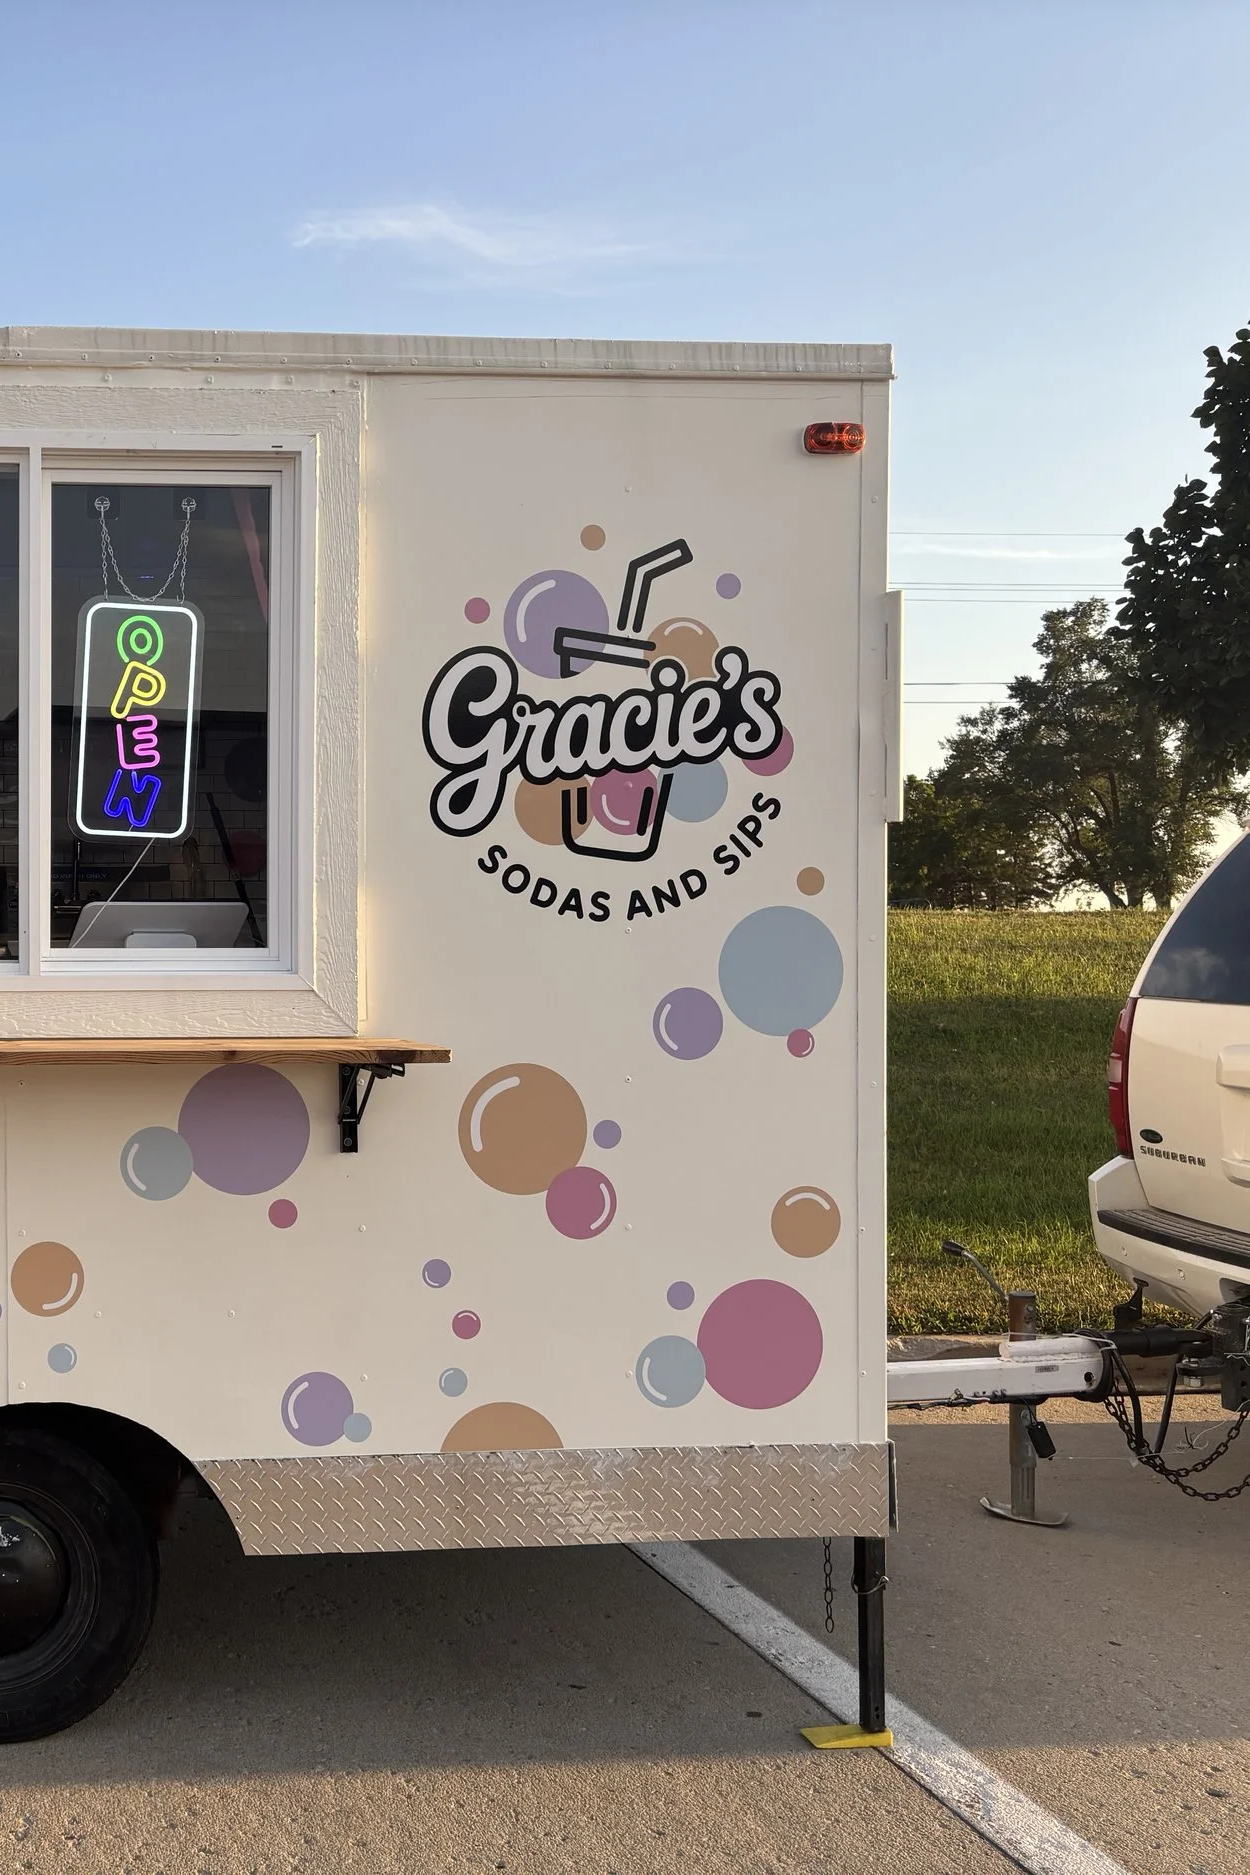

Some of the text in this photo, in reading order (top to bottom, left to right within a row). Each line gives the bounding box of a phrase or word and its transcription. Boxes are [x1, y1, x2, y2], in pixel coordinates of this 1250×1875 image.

[104, 615, 167, 828] OPEN
[422, 646, 783, 838] Gracie's
[477, 792, 782, 922] SODAS AND SIPS
[1139, 1145, 1206, 1167] SUBURBAN
